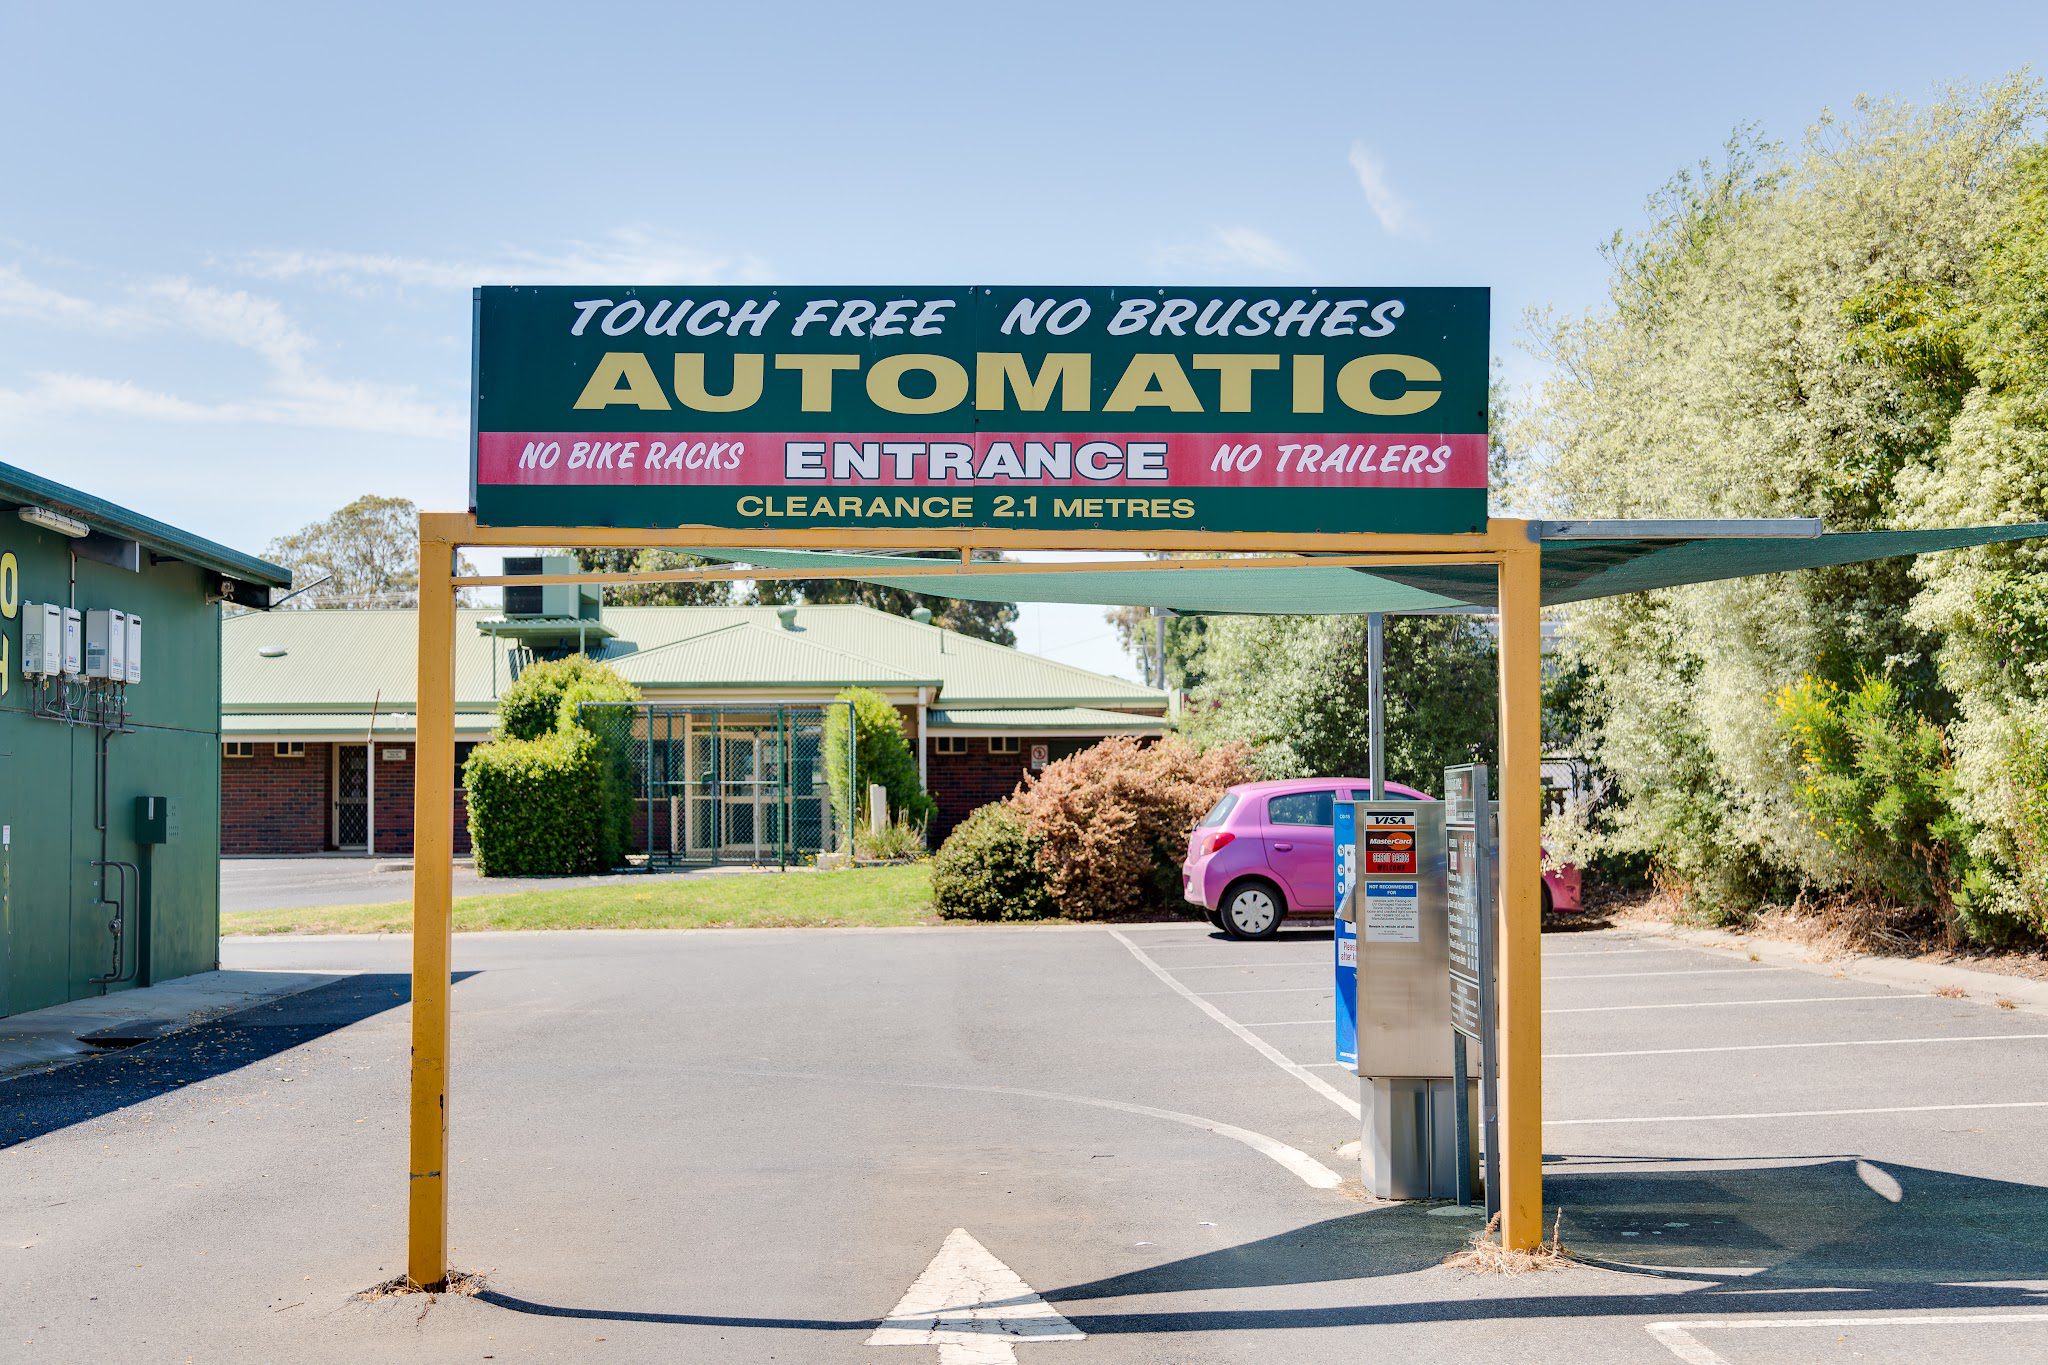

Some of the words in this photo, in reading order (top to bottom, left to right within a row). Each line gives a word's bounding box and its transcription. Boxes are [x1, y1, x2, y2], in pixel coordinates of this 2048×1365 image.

[571, 299, 781, 337] TOUCH
[791, 299, 956, 337] FREE
[1000, 298, 1092, 336] NO
[1106, 298, 1405, 338] BRUSHES
[572, 351, 1442, 416] AUTOMATIC
[518, 441, 561, 470] NO
[567, 441, 640, 470] BIKE
[643, 441, 745, 471] RACKS
[784, 441, 1168, 480] ENTRANCE
[1210, 444, 1263, 473] NO
[1275, 443, 1452, 475] TRAILERS
[736, 495, 974, 518] CLEARANCE
[992, 495, 1037, 518] 2.1
[1053, 498, 1196, 519] METRES
[1374, 816, 1406, 825] VISA
[1343, 941, 1356, 951] Pleas
